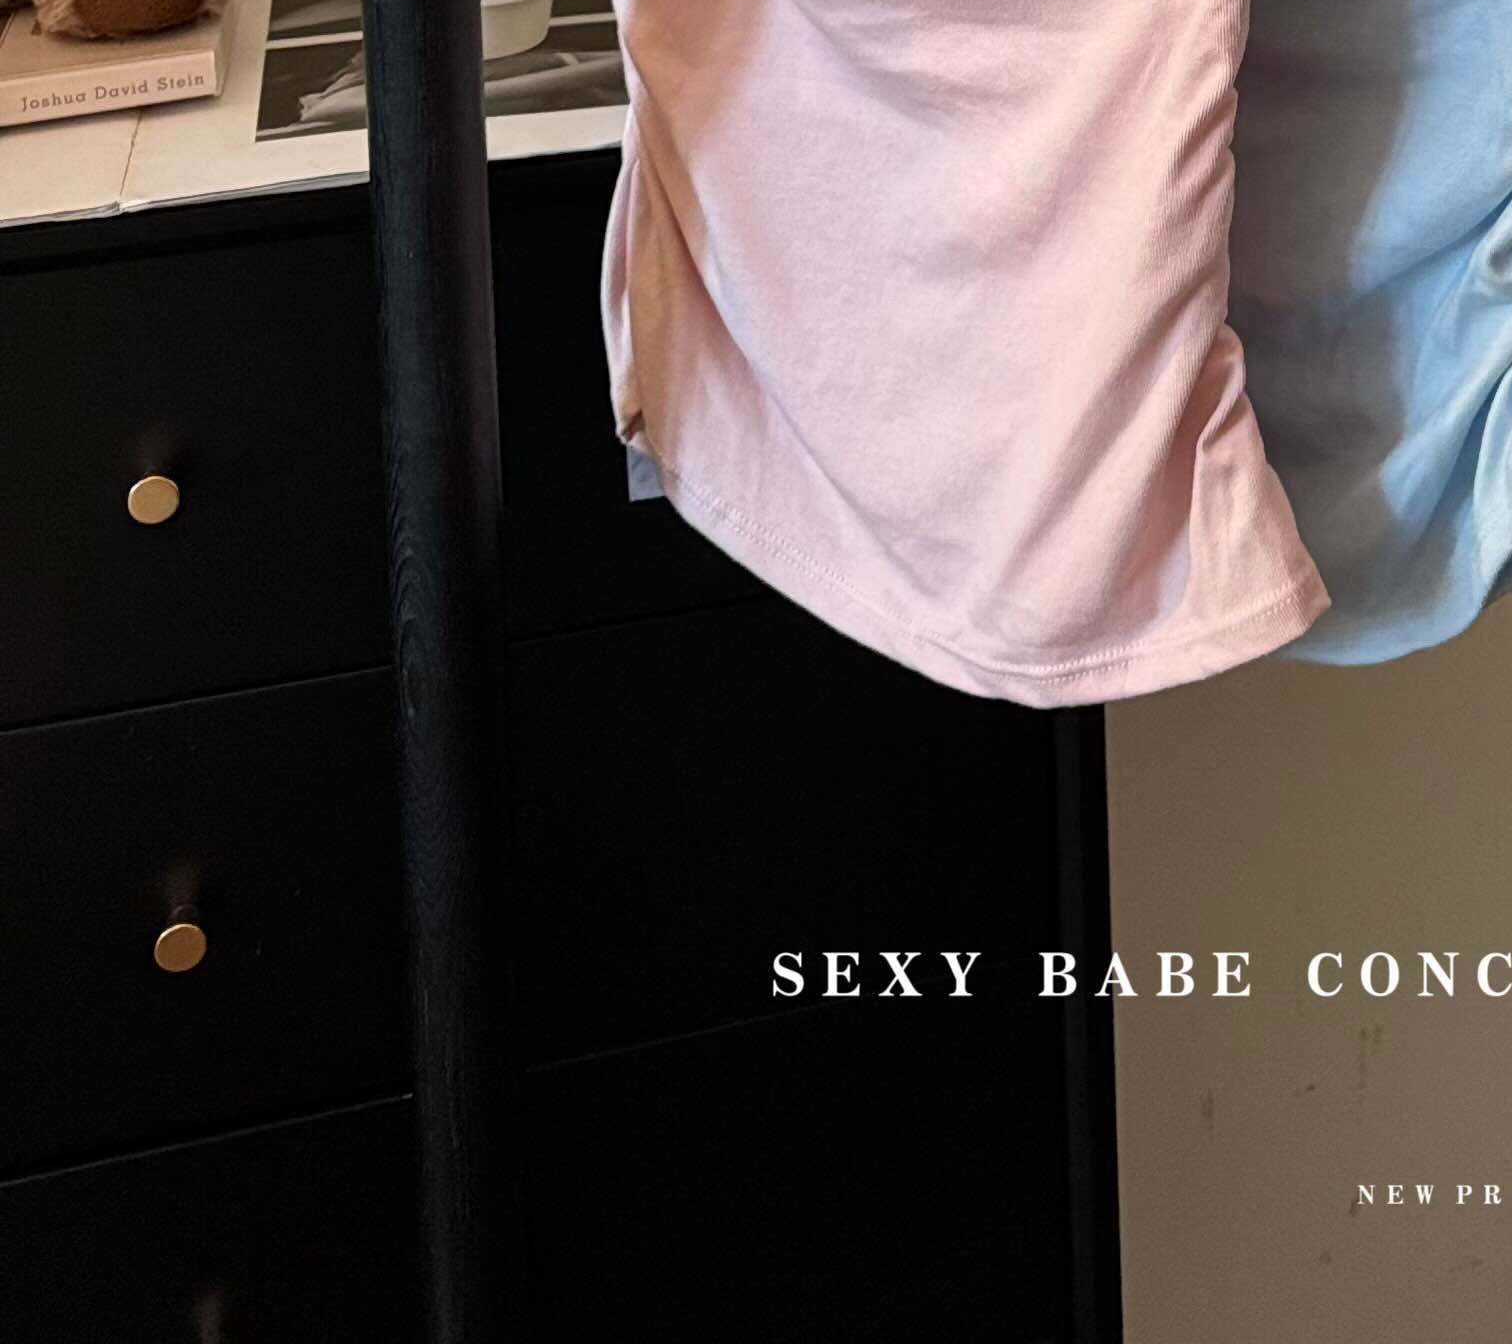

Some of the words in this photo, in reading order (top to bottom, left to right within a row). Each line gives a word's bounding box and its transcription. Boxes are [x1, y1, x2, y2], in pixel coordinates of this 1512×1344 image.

[21, 91, 87, 112] Joshua
[95, 80, 149, 101] David
[157, 73, 205, 91] Stein
